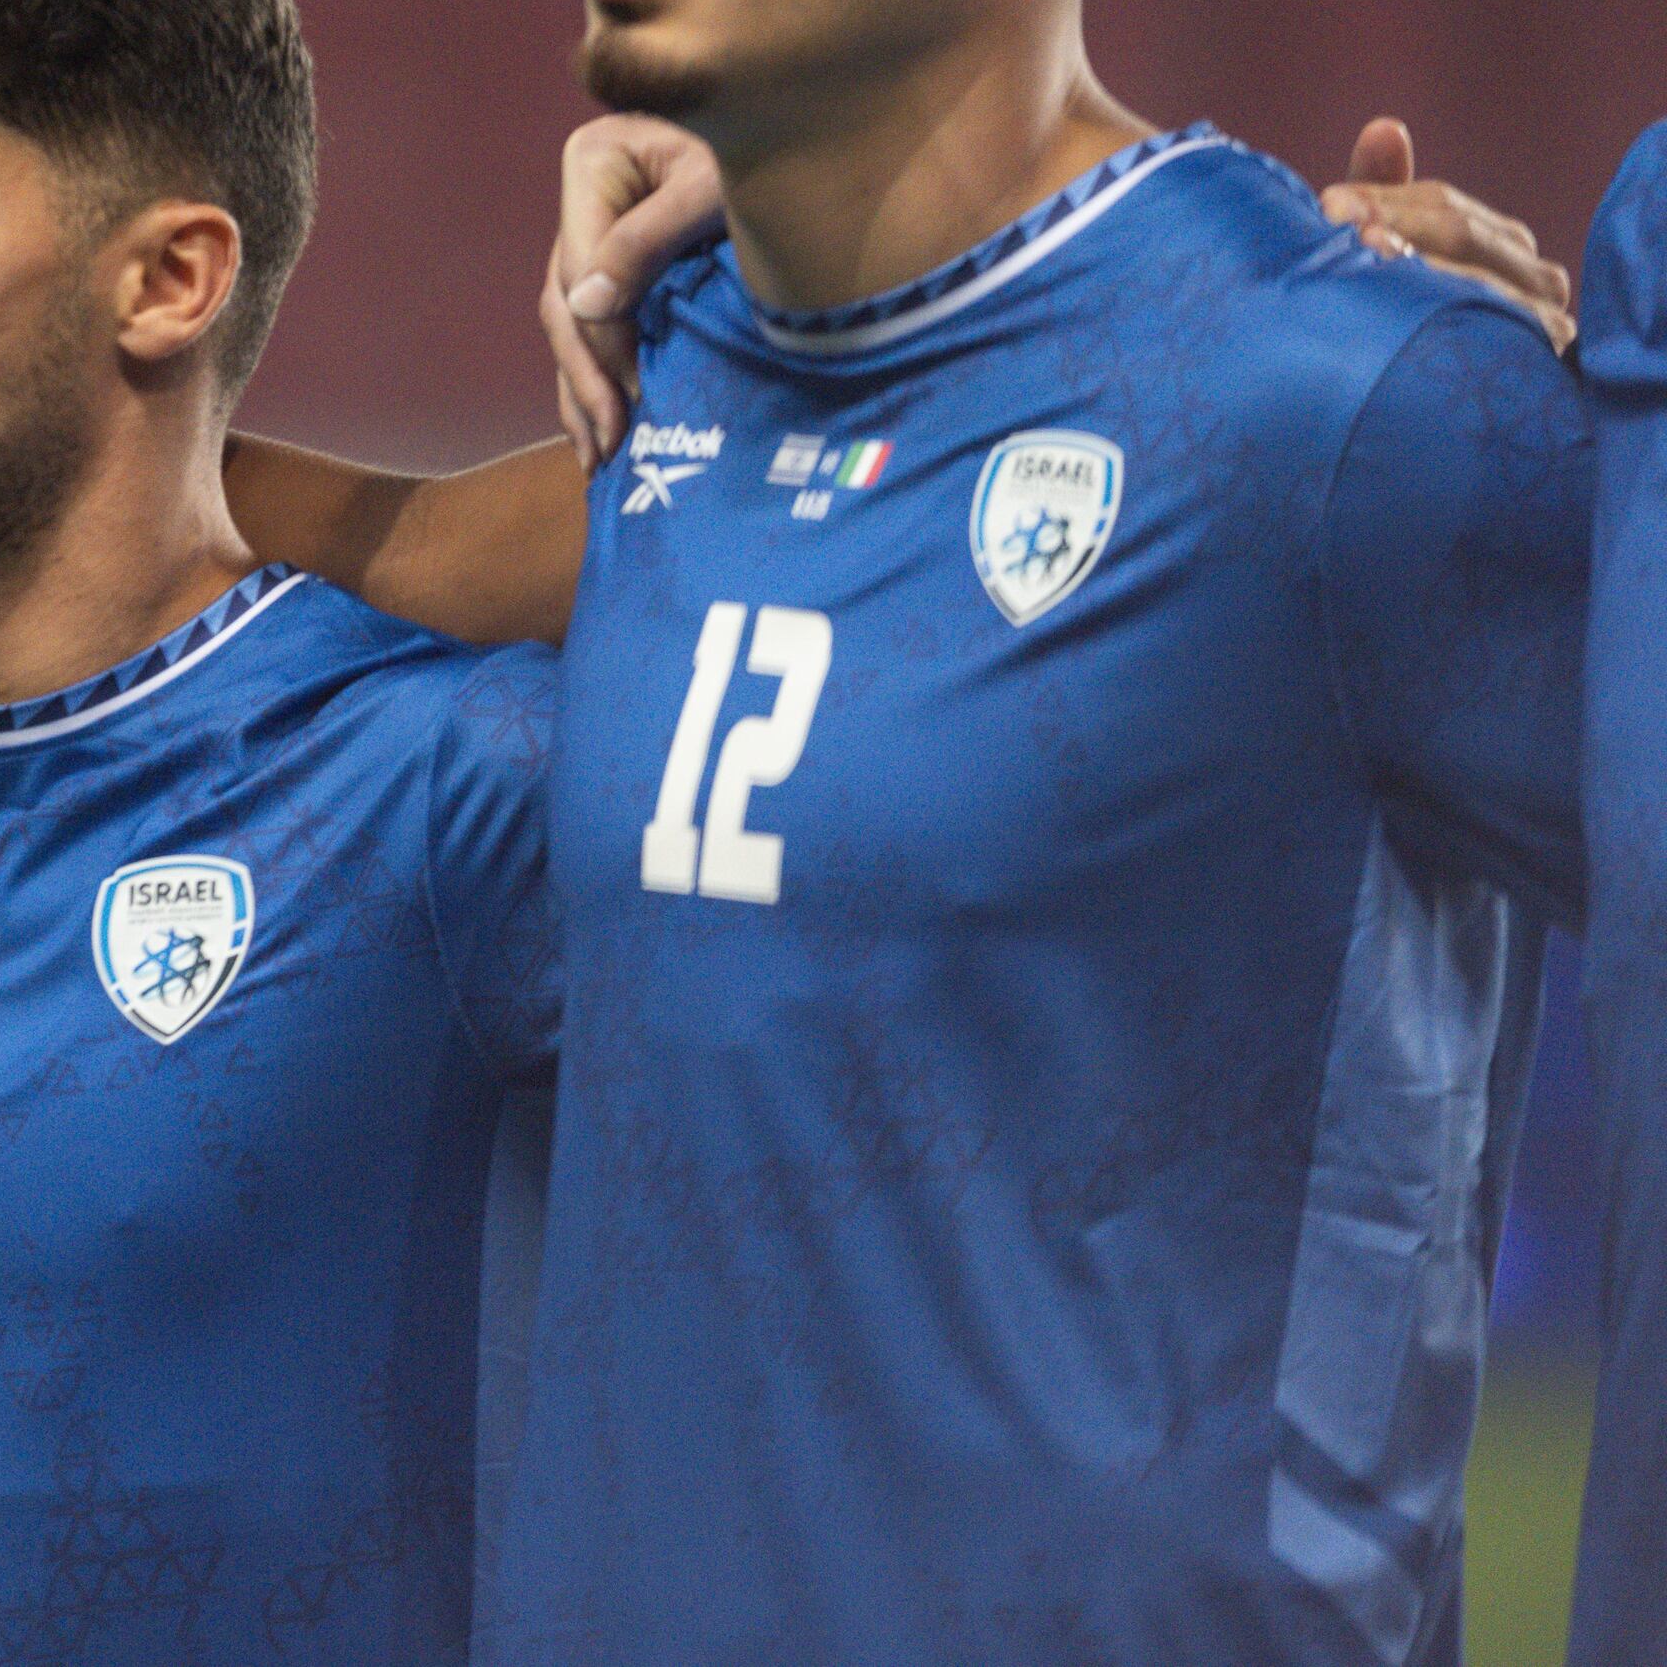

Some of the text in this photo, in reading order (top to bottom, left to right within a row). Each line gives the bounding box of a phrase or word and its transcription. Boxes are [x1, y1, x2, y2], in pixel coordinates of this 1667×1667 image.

[629, 421, 727, 463] Reebok
[641, 601, 834, 905] 12
[129, 877, 224, 907] ISRAEL
